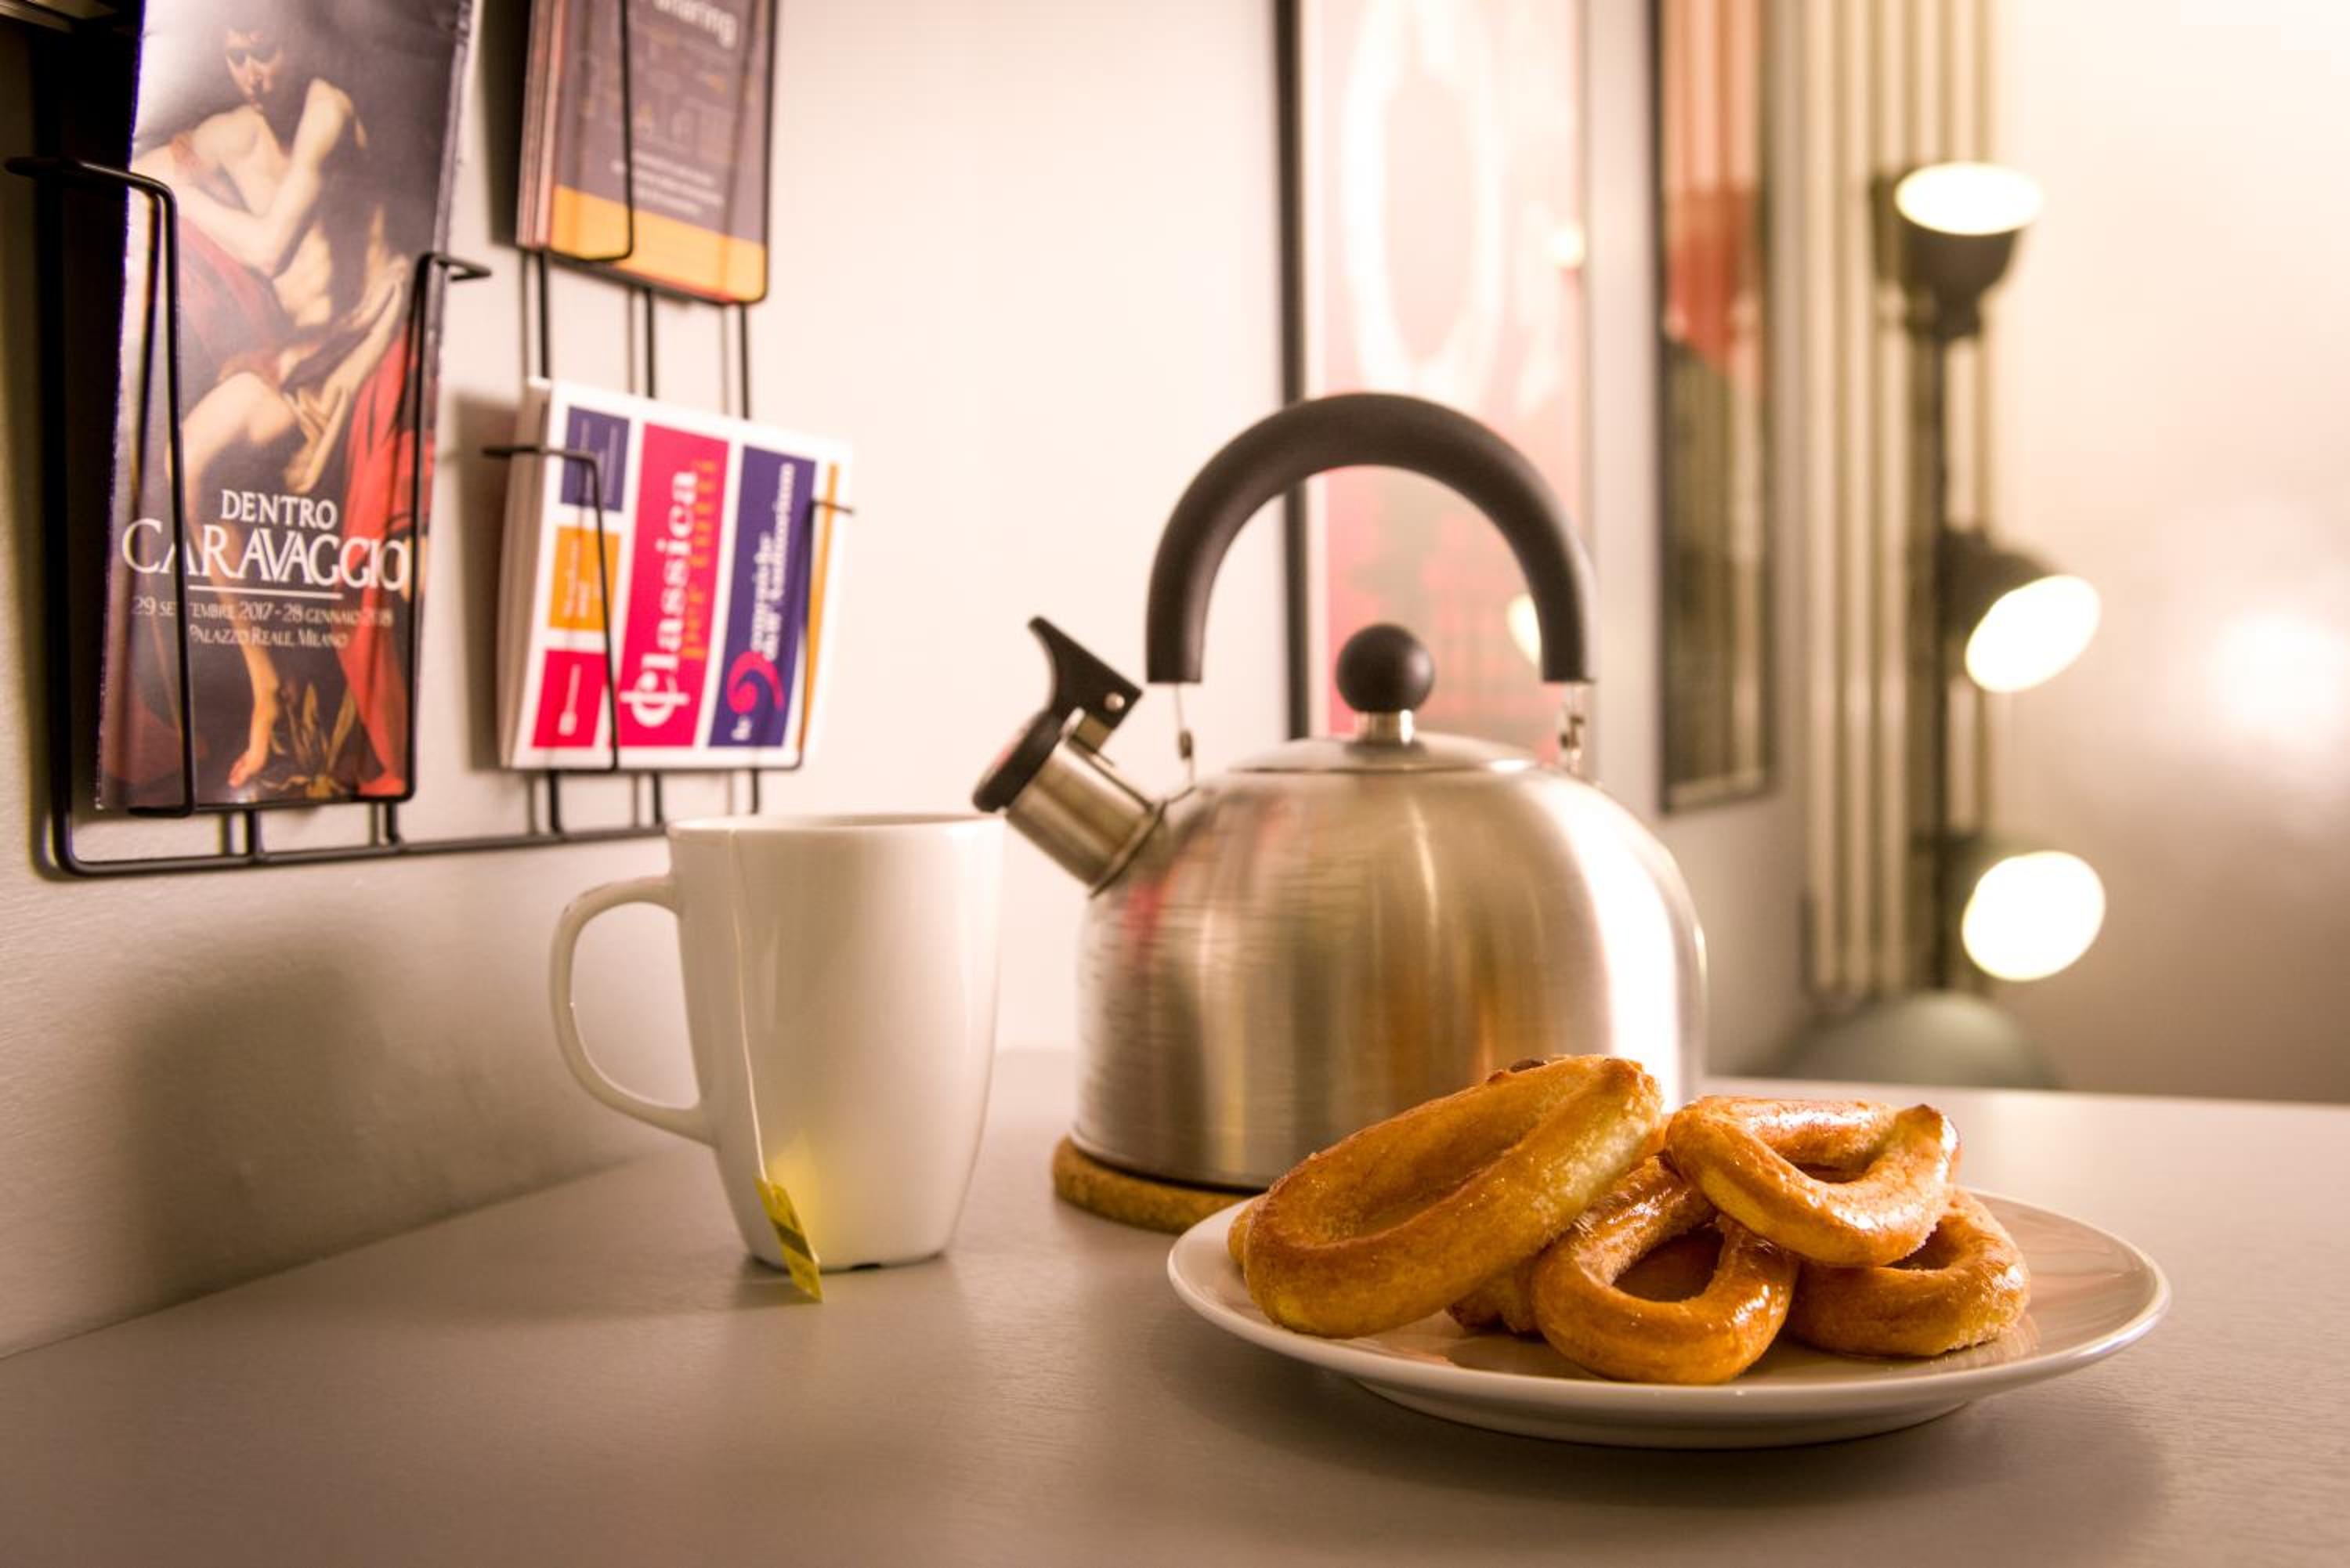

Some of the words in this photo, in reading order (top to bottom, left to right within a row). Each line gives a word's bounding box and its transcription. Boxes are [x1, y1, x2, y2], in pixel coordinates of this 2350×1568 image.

[221, 489, 338, 530] DENTRO
[121, 518, 410, 591] CARAVAGGIO
[132, 596, 156, 616] 29
[159, 601, 237, 620] SEEMBRE
[239, 601, 274, 621] 2017
[619, 471, 698, 728] Classica
[189, 623, 250, 645] PALAZZO
[298, 628, 349, 649] MILANO
